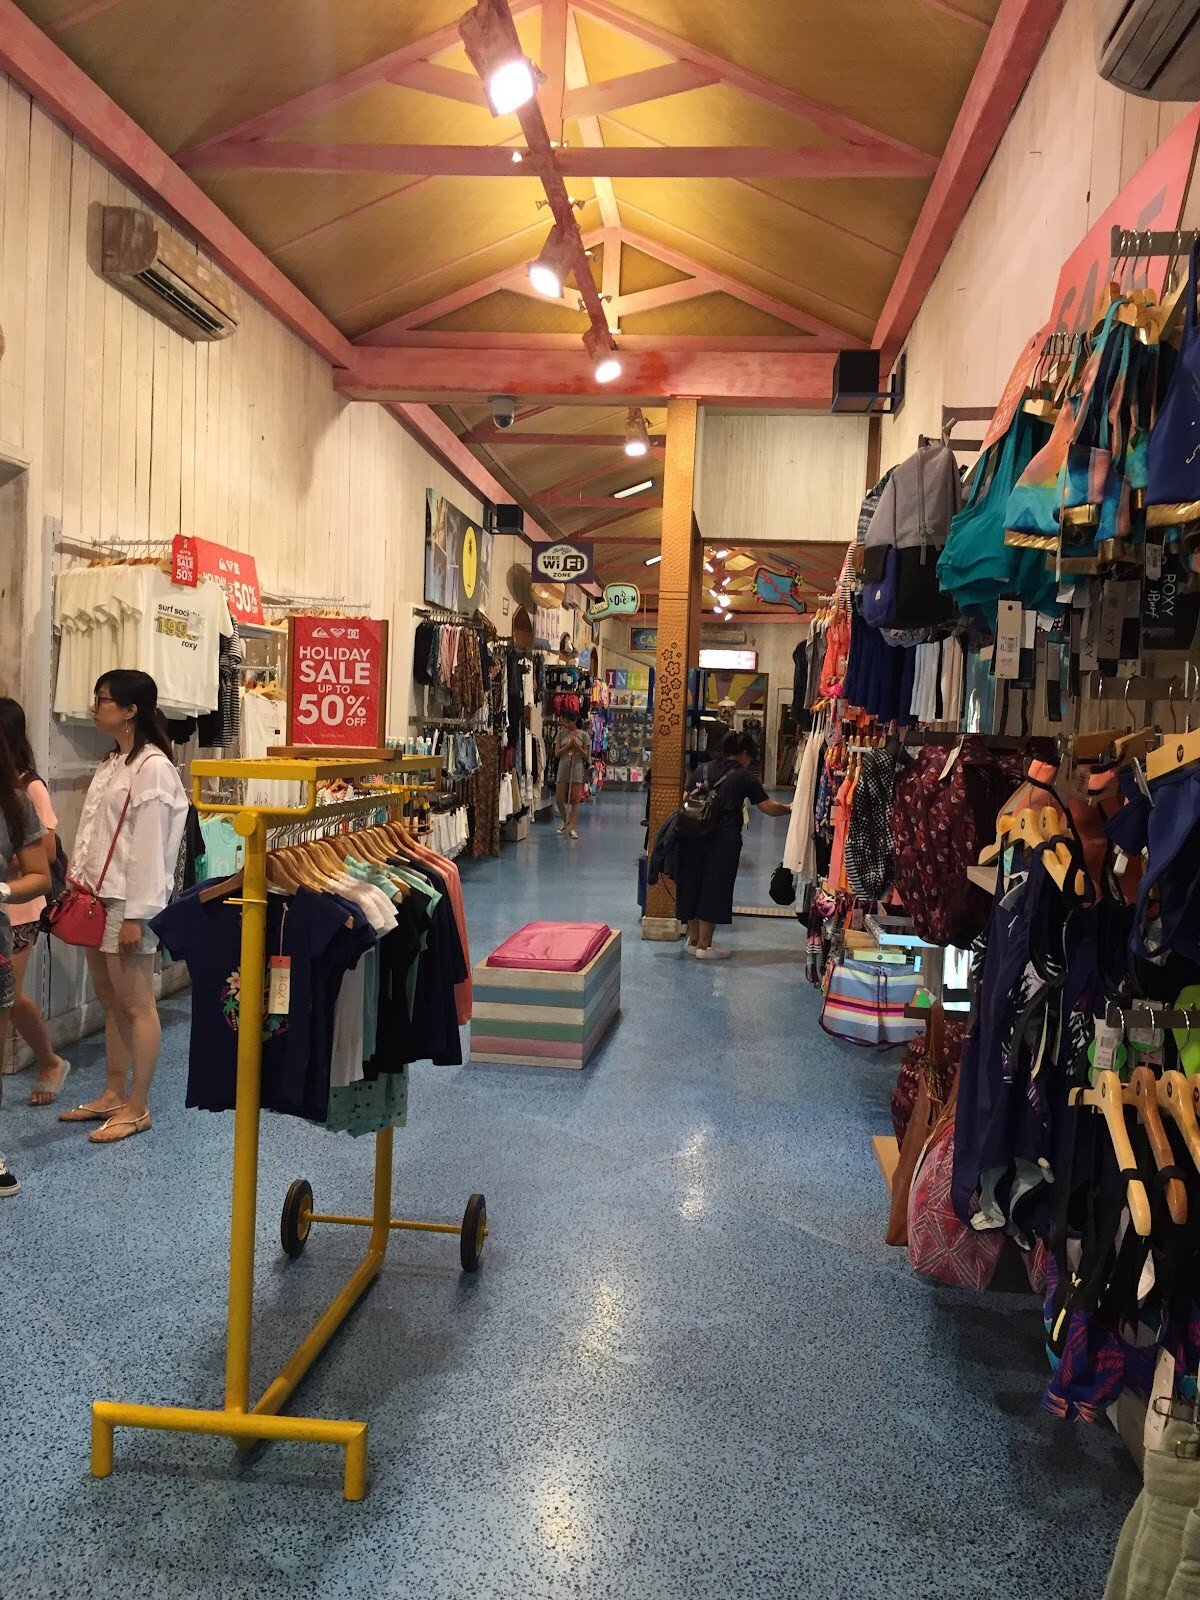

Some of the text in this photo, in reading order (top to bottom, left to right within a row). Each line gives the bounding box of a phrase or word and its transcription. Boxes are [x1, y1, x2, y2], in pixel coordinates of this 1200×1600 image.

[176, 558, 194, 569] SALE
[1162, 573, 1177, 617] ROXY
[158, 603, 173, 613] surf
[181, 640, 198, 651] roxy
[299, 645, 371, 661] HOLIDAY
[299, 660, 371, 685] SALE
[317, 684, 350, 694] UP TO
[345, 717, 367, 727] OFF
[277, 975, 288, 1008] ROXY
